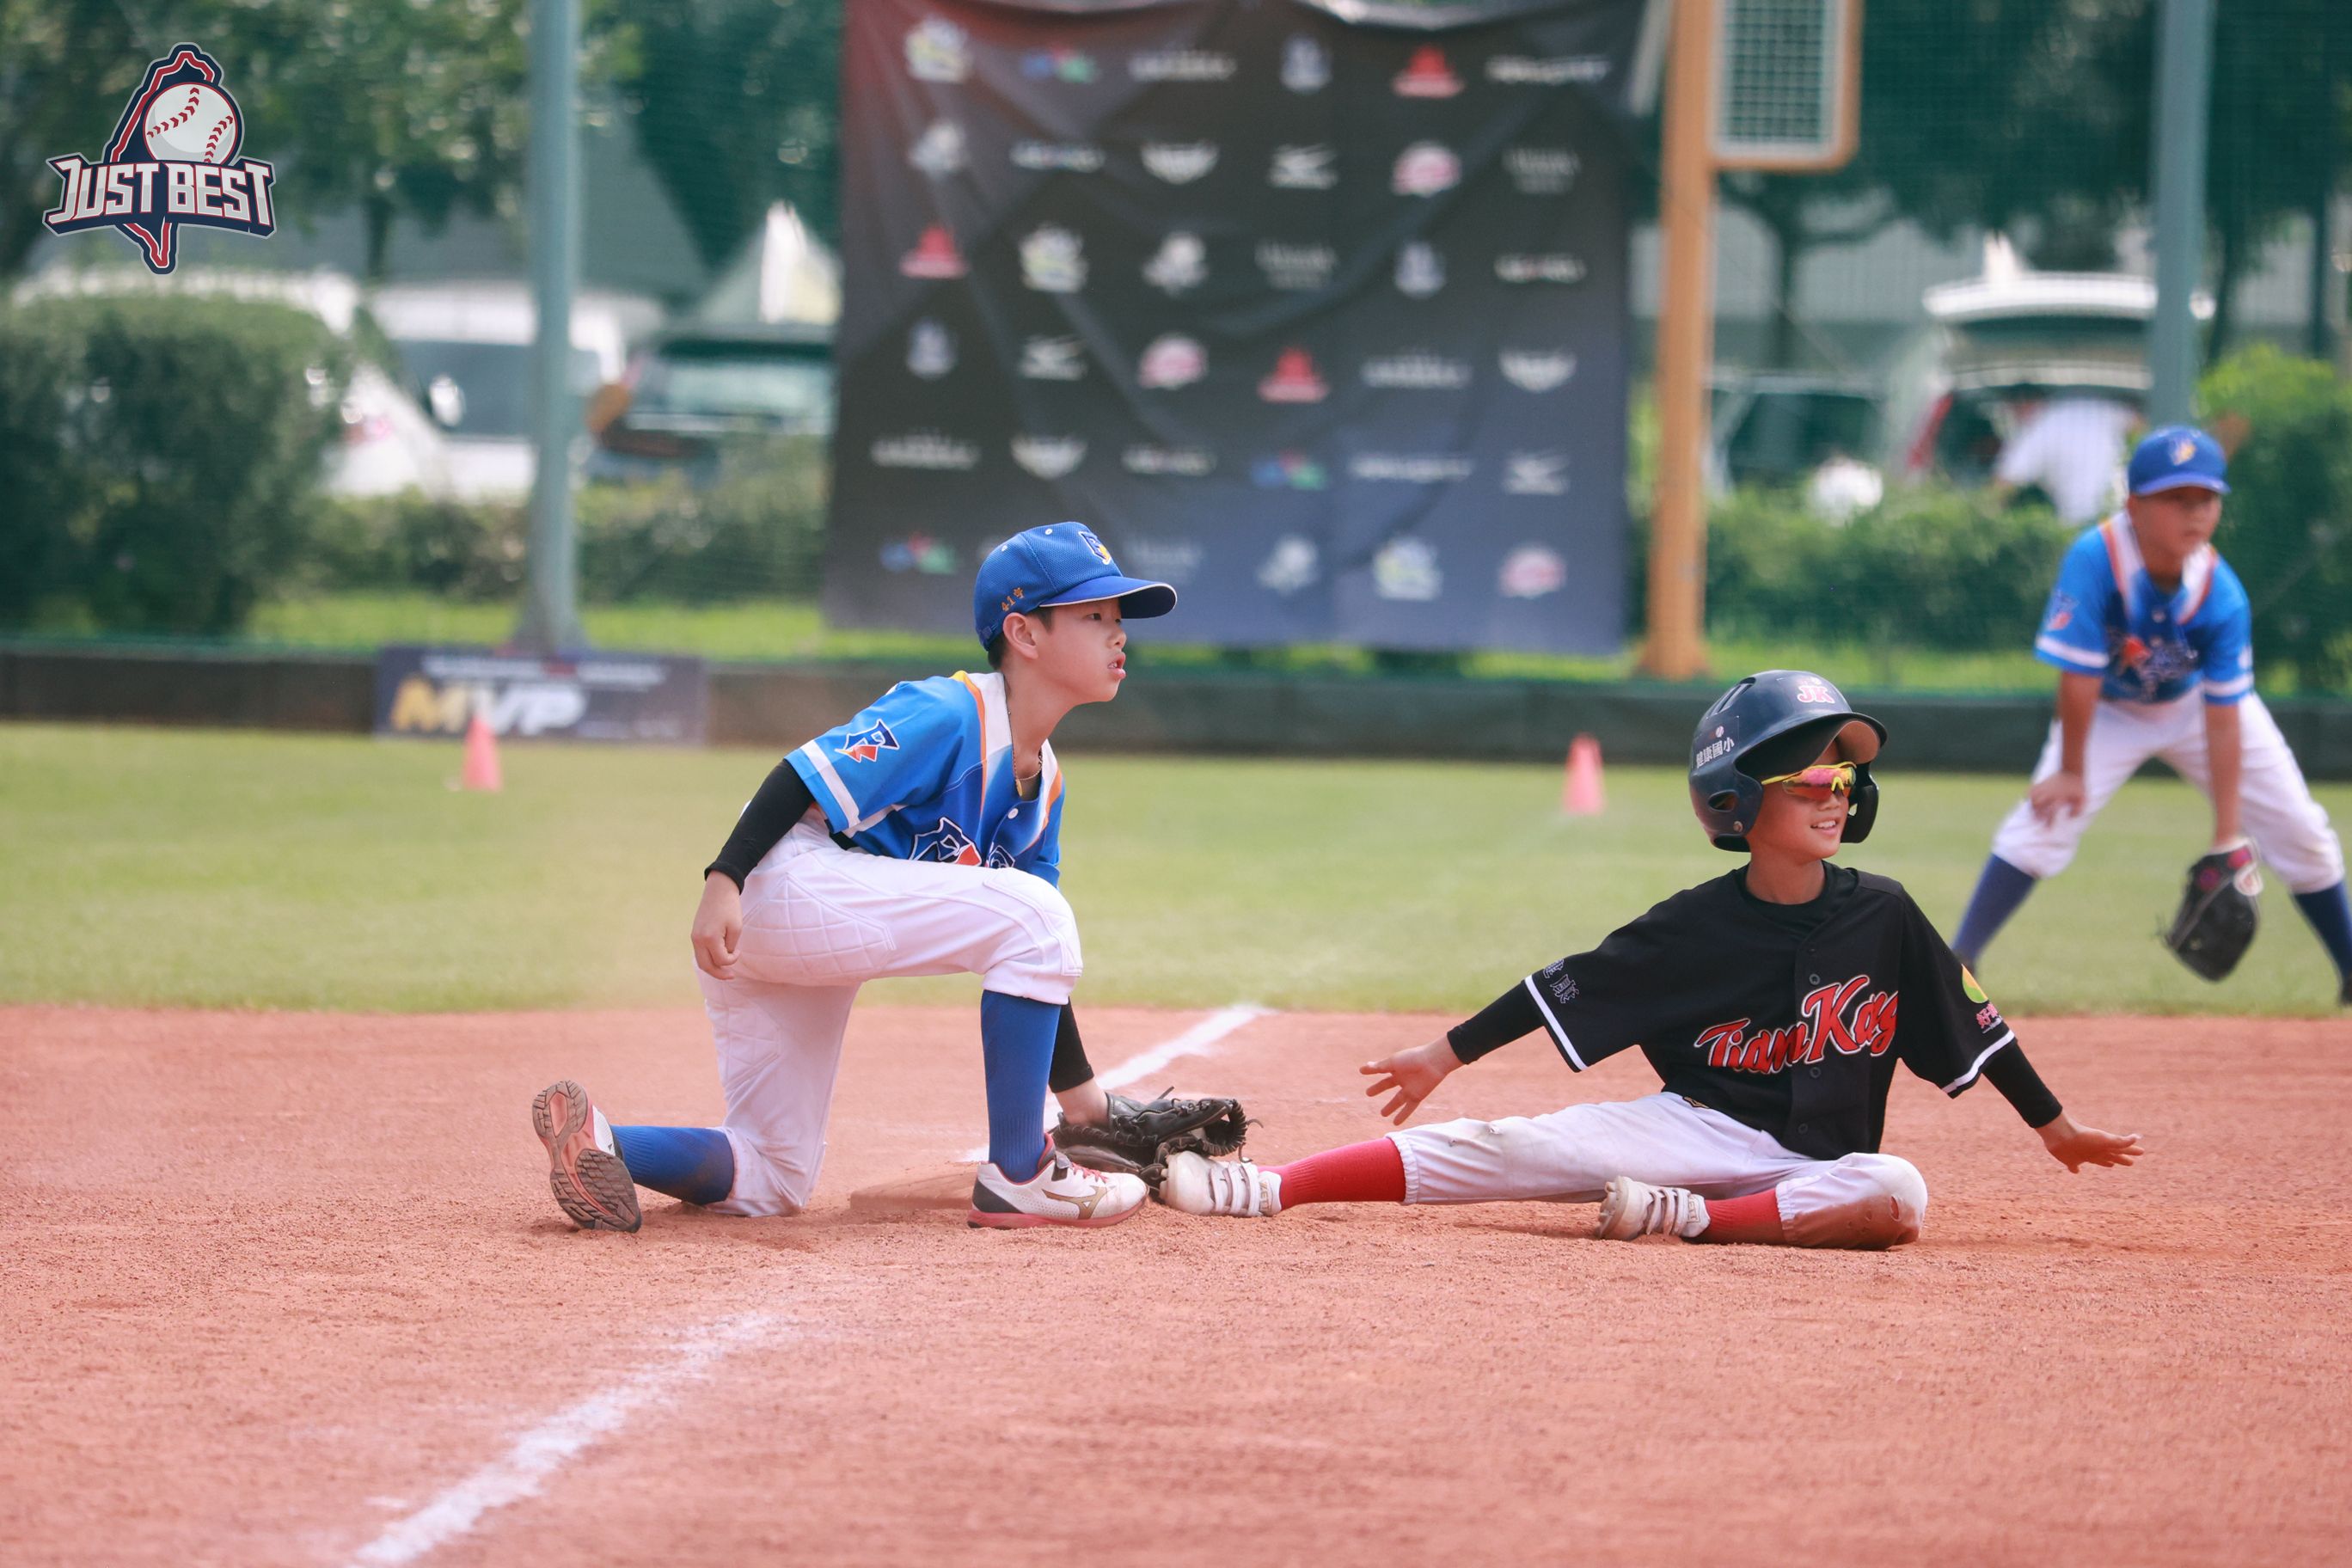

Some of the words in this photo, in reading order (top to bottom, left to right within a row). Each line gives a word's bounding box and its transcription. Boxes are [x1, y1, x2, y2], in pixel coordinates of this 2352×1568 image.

[391, 675, 588, 736] MVP
[1797, 685, 1835, 703] JK
[1696, 737, 1735, 769] 健康國小
